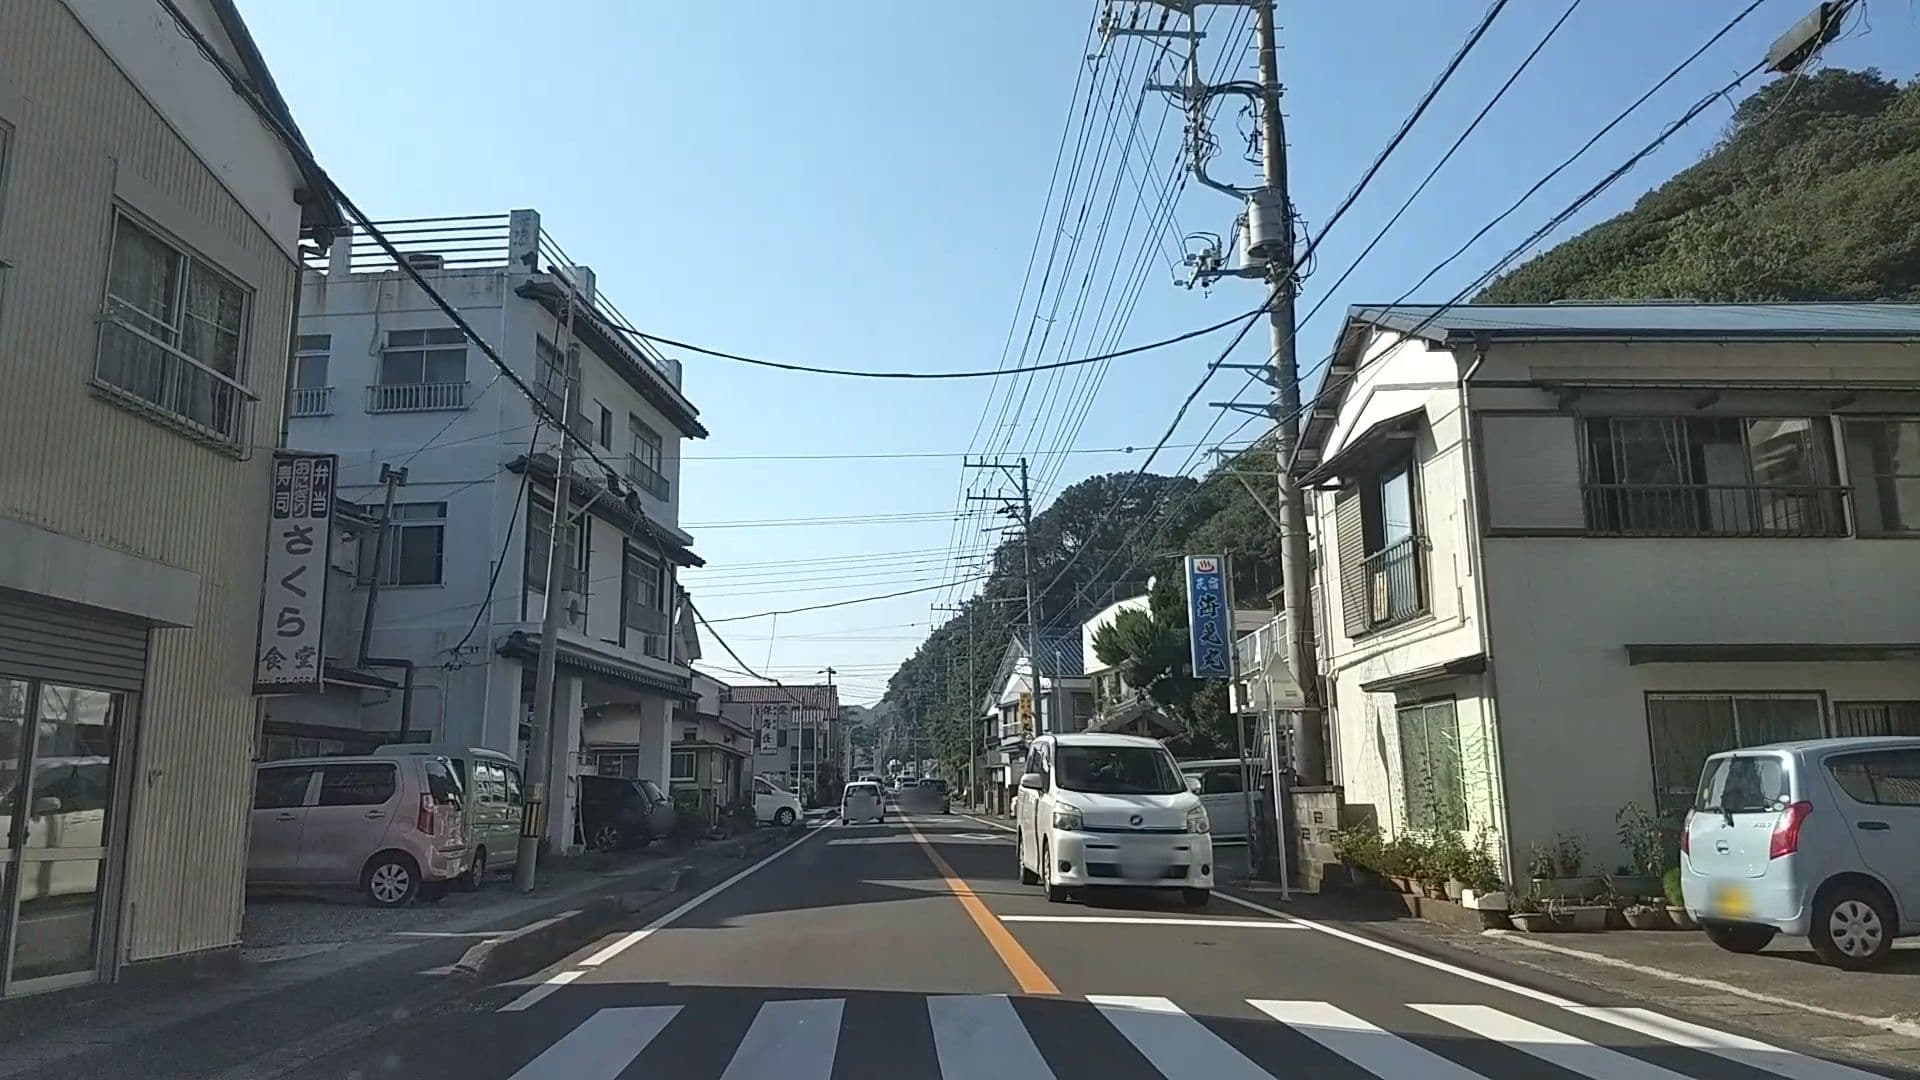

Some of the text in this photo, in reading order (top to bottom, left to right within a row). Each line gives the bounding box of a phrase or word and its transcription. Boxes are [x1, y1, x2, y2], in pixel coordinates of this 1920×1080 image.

[276, 465, 292, 513] 寿司
[312, 464, 329, 512] 弁当
[277, 524, 313, 638] さくら
[262, 645, 317, 671] 食堂
